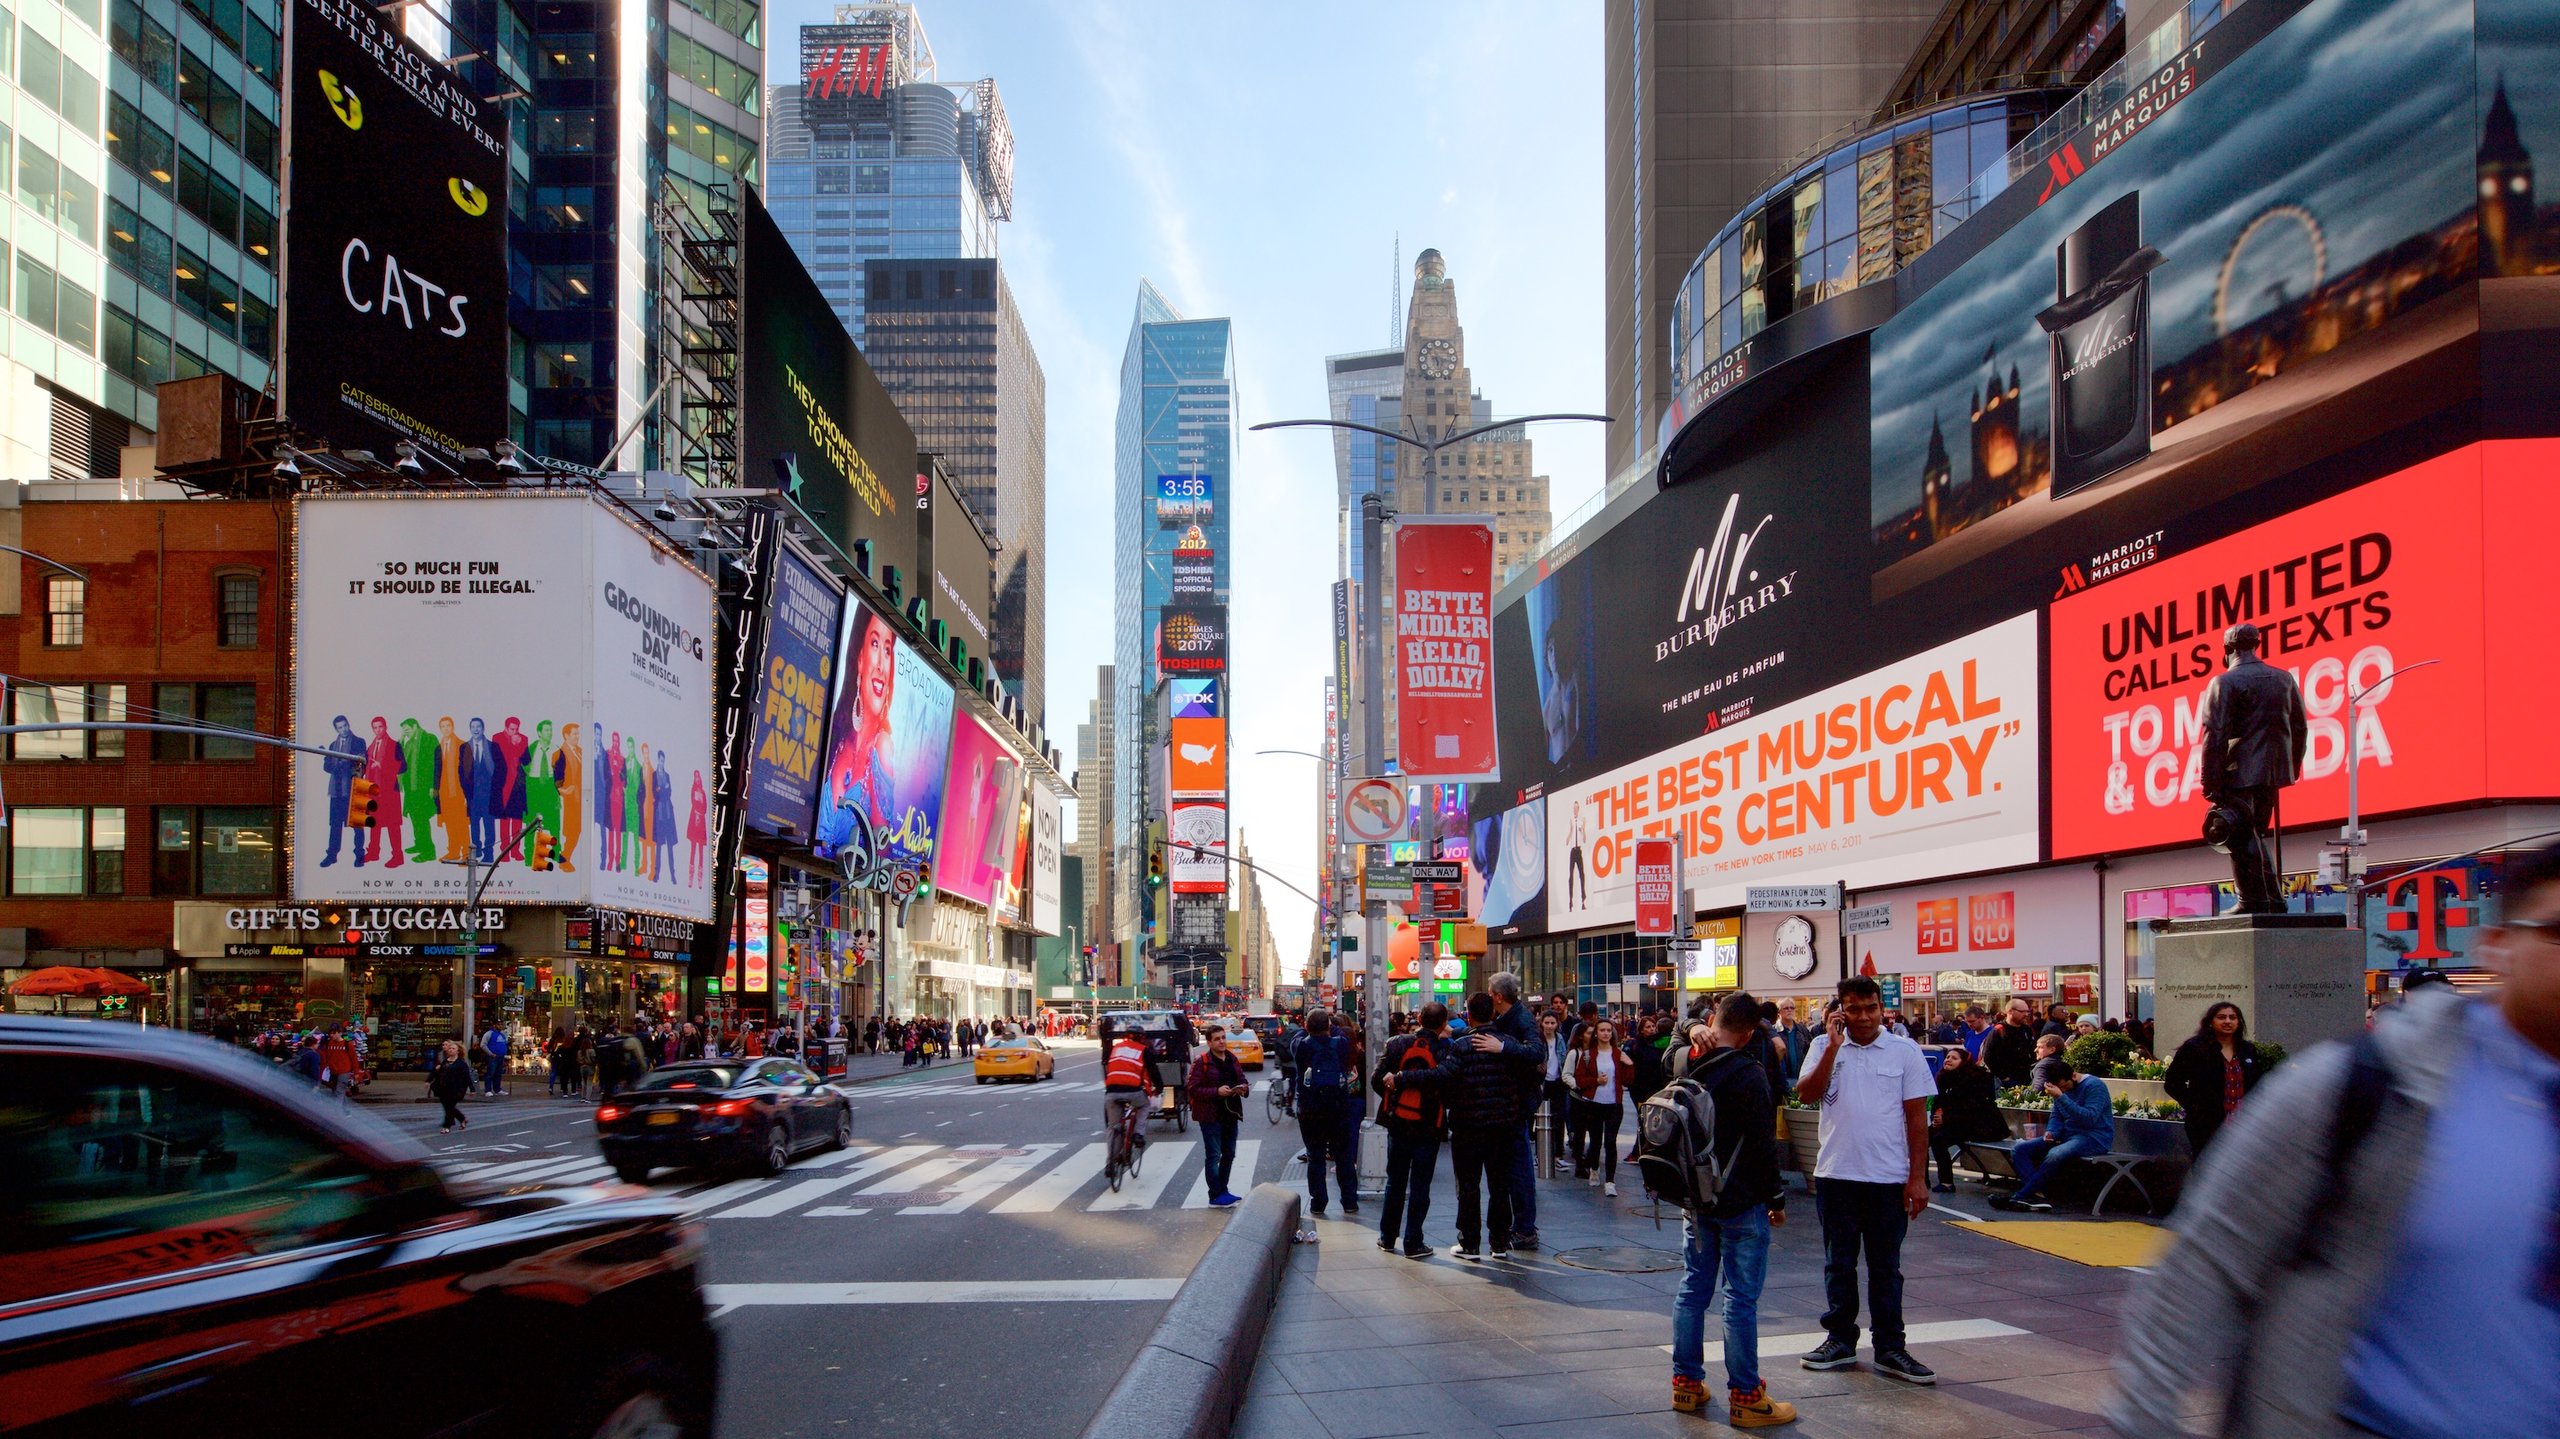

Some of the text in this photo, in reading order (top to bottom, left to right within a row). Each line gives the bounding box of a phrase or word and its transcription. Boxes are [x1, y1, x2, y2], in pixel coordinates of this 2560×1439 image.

[383, 29, 477, 118] BACK AND
[391, 56, 446, 113] THAN
[806, 44, 890, 100] H&M
[2094, 40, 2206, 138] MARRIOTT
[2094, 75, 2191, 159] MARQUIS
[340, 237, 469, 338] CATS
[1689, 341, 1754, 397] MARRIOTT
[2062, 331, 2137, 382] BURBERRY
[1689, 364, 1744, 414] MARQUIS
[340, 382, 466, 451] CATSBROADWAY.COM
[348, 396, 363, 410] Neil
[364, 404, 387, 423] Simon
[387, 416, 414, 437] Theatre
[785, 363, 817, 413] THEY
[816, 405, 860, 470] SHOWED
[859, 457, 878, 491] THE
[543, 457, 601, 478] LAMAR
[806, 415, 882, 517] TO THE WORLD
[1164, 480, 1205, 497] 3:56
[1550, 531, 1581, 559] MARRIOTT
[1550, 545, 1578, 571] MARQUIS
[2091, 530, 2165, 568] MARRIOTT
[415, 561, 500, 575] MUCH FUN
[1172, 566, 1214, 574] TOSHIBA
[2091, 547, 2156, 582] MARQUIS
[349, 580, 366, 595] IT
[373, 580, 435, 595] SHOULD
[440, 580, 462, 594] BE
[1173, 584, 1206, 593] SPONSOR
[1182, 575, 1213, 584] OFFICIAL
[937, 570, 988, 641] THE ART OF ESSENCE
[1403, 589, 1484, 614] BETTE
[2102, 532, 2393, 664] UNLIMITED
[604, 581, 703, 662] GROUNDHOG
[1187, 625, 1214, 633] TIMES
[1398, 613, 1490, 639] MIDLER
[1654, 570, 1798, 663] BURBERRY
[642, 629, 671, 667] DAY
[1192, 632, 1225, 641] SQUARE
[2103, 590, 2393, 703] CALLS TEXTS
[1162, 657, 1225, 670] TOSHIBA
[1341, 639, 1349, 683] opportunity
[1405, 639, 1486, 669] HELLO,
[632, 651, 681, 688] THE MUSICAL
[1406, 665, 1485, 691] DOLLY!
[1662, 650, 1785, 714] THE NEW EAU DE PARFUM
[770, 655, 826, 720] COME
[1183, 693, 1215, 704] TDK
[1341, 683, 1349, 721] engage
[1720, 696, 1755, 716] MARRIOTT
[2102, 644, 2395, 764] TO MCO
[764, 687, 822, 749] FROM
[1720, 706, 1751, 726] MARQUIS
[1657, 738, 1749, 814] BEST
[1758, 657, 2001, 781] MUSICAL
[759, 727, 818, 782] AWAY
[2103, 704, 2394, 816] & CADA
[890, 805, 934, 859] Aladdin
[1037, 805, 1058, 842] NOW
[1394, 845, 1417, 861] 66
[1591, 828, 1635, 879] OF
[1641, 804, 1723, 859] THIS
[1713, 834, 1862, 873] THE NEW YORK TIMES MAY 6, 2011
[1037, 843, 1058, 876] OPEN
[1414, 867, 1432, 877] ONE
[1435, 867, 1456, 877] WAY
[1638, 864, 1670, 874] BETTE
[363, 879, 395, 889] NOW
[404, 879, 424, 889] ON
[1384, 874, 1406, 882] Square
[1637, 873, 1672, 883] MIDLER
[617, 886, 635, 896] NOW
[639, 889, 649, 899] ON
[653, 892, 691, 906] BROADWAY
[1749, 887, 1828, 898] PEDESTRIAN FLOW ZONE
[1750, 899, 1793, 909] KEEP MOVING
[225, 907, 505, 931] GIFTS LUGGAGE
[1869, 909, 1880, 919] FLOW
[1879, 905, 1890, 916] ZONE
[1974, 898, 2006, 921] UNI
[2386, 867, 2470, 960] T
[339, 931, 390, 944] I NY
[637, 914, 695, 942] LUGGAGE
[1973, 922, 2010, 947] QLO
[238, 947, 261, 956] Apple
[270, 945, 304, 956] Nikon
[314, 945, 360, 957] Canon
[370, 946, 414, 955] SONY
[641, 935, 656, 948] NY
[653, 950, 675, 961] SONY
[1718, 944, 1738, 967] $79
[2032, 971, 2047, 981] UNI
[2032, 980, 2047, 990] QLO
[553, 977, 563, 1002] ATM
